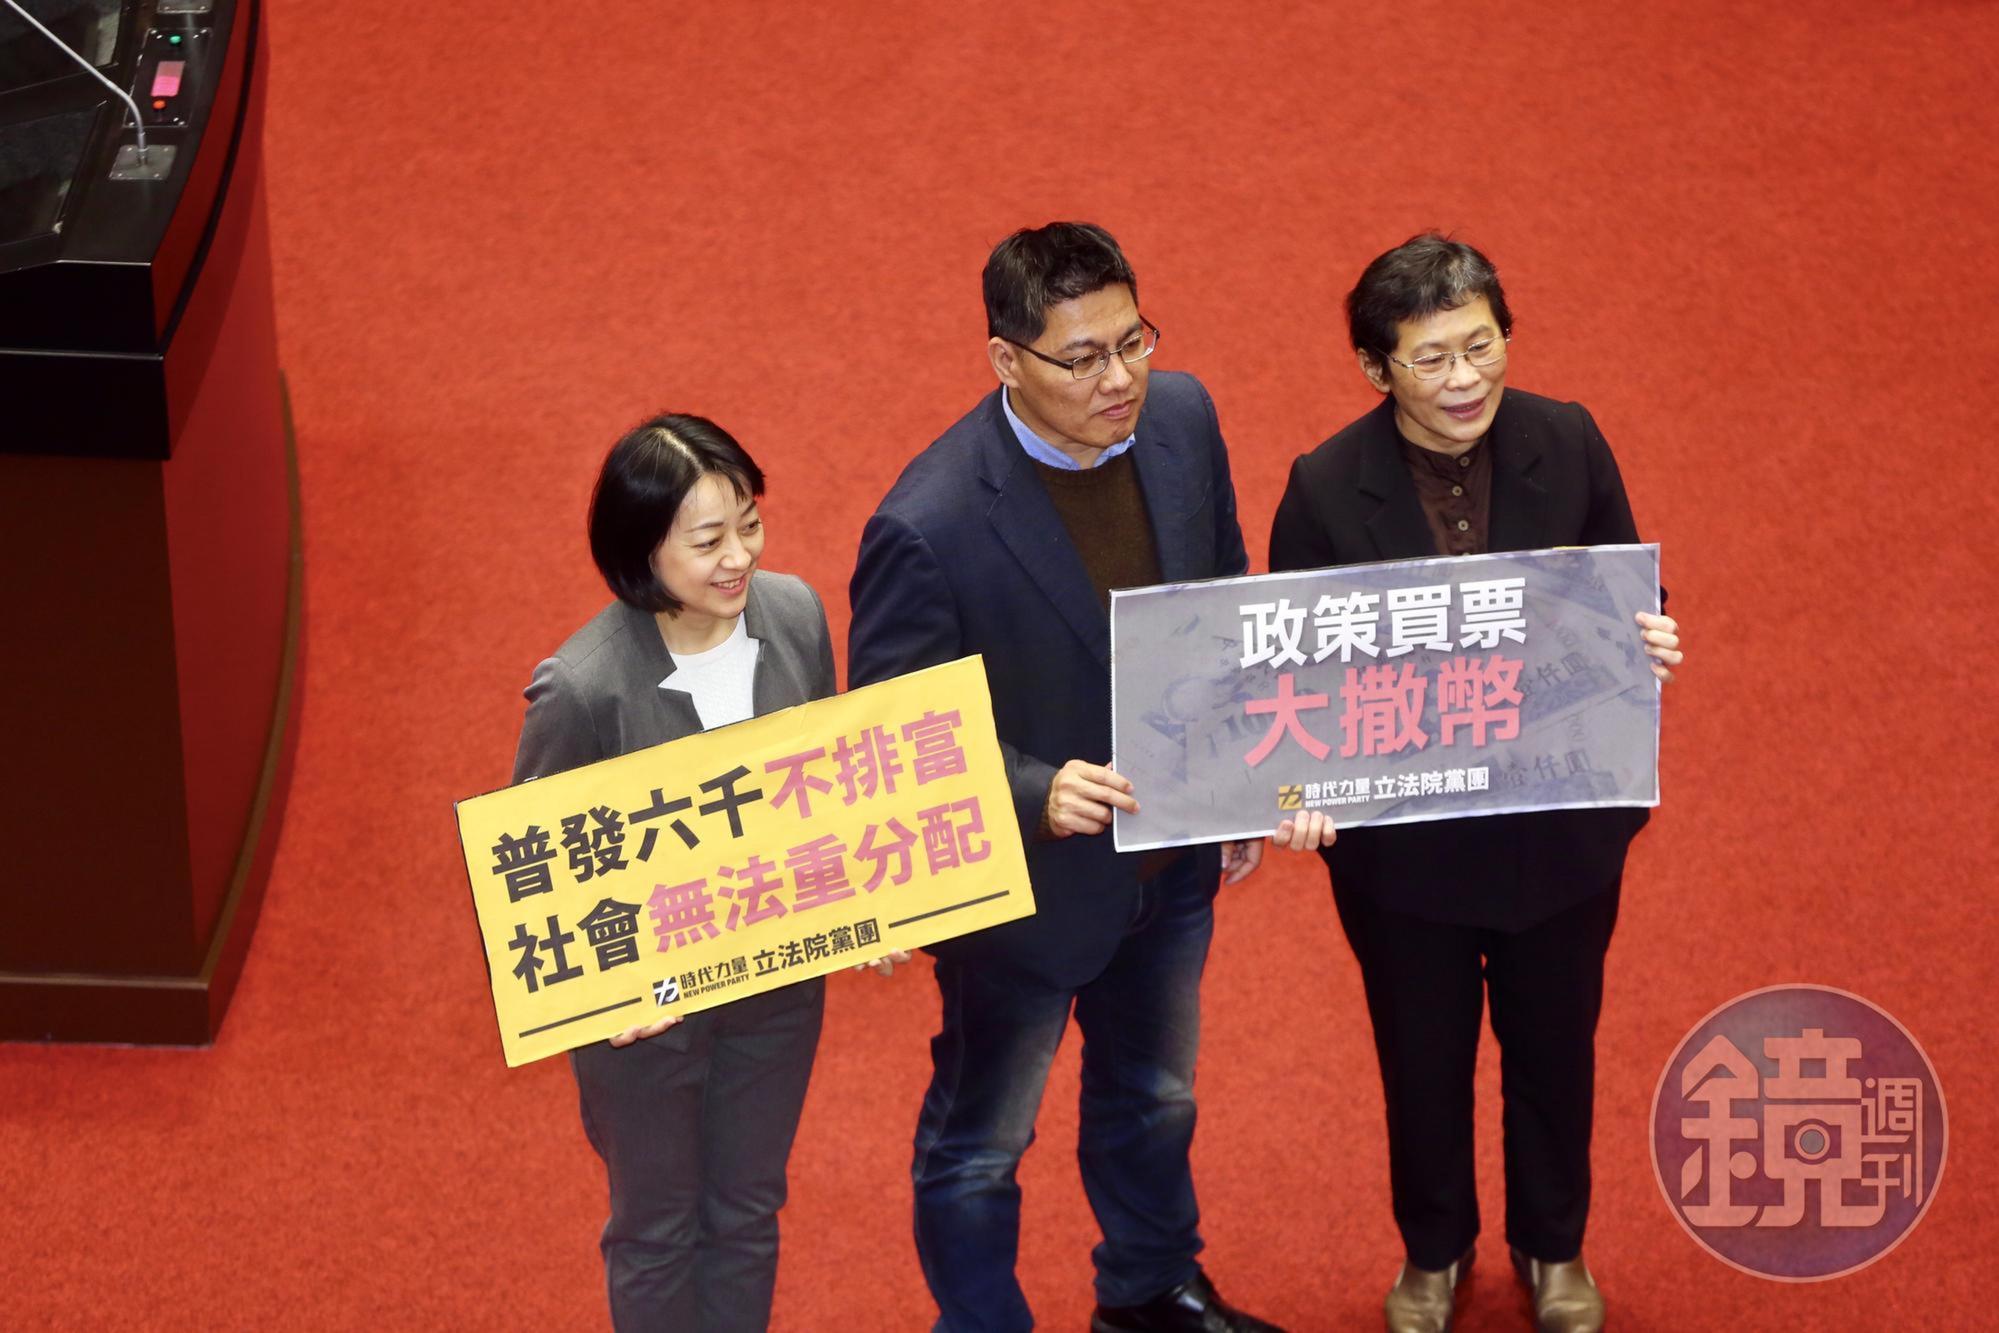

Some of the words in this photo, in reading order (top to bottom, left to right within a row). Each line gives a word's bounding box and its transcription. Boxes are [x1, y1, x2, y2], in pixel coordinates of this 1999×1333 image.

[1239, 577, 1527, 669] 政策買票
[1243, 654, 1525, 767] 大撒幣
[491, 709, 968, 903] 普發六千不排富
[1305, 778, 1370, 799] 時代力量
[1373, 767, 1489, 799] 立法院黨團
[1305, 798, 1321, 808] NEW
[1322, 797, 1346, 806] POWER
[1348, 795, 1369, 805] PARTY
[508, 796, 991, 994] 社會無法重分配
[680, 956, 748, 990] 時代力量
[752, 918, 881, 977] 立法院黨團
[683, 988, 700, 999] NEW
[700, 979, 727, 996] POWER
[727, 974, 750, 987] PARTY
